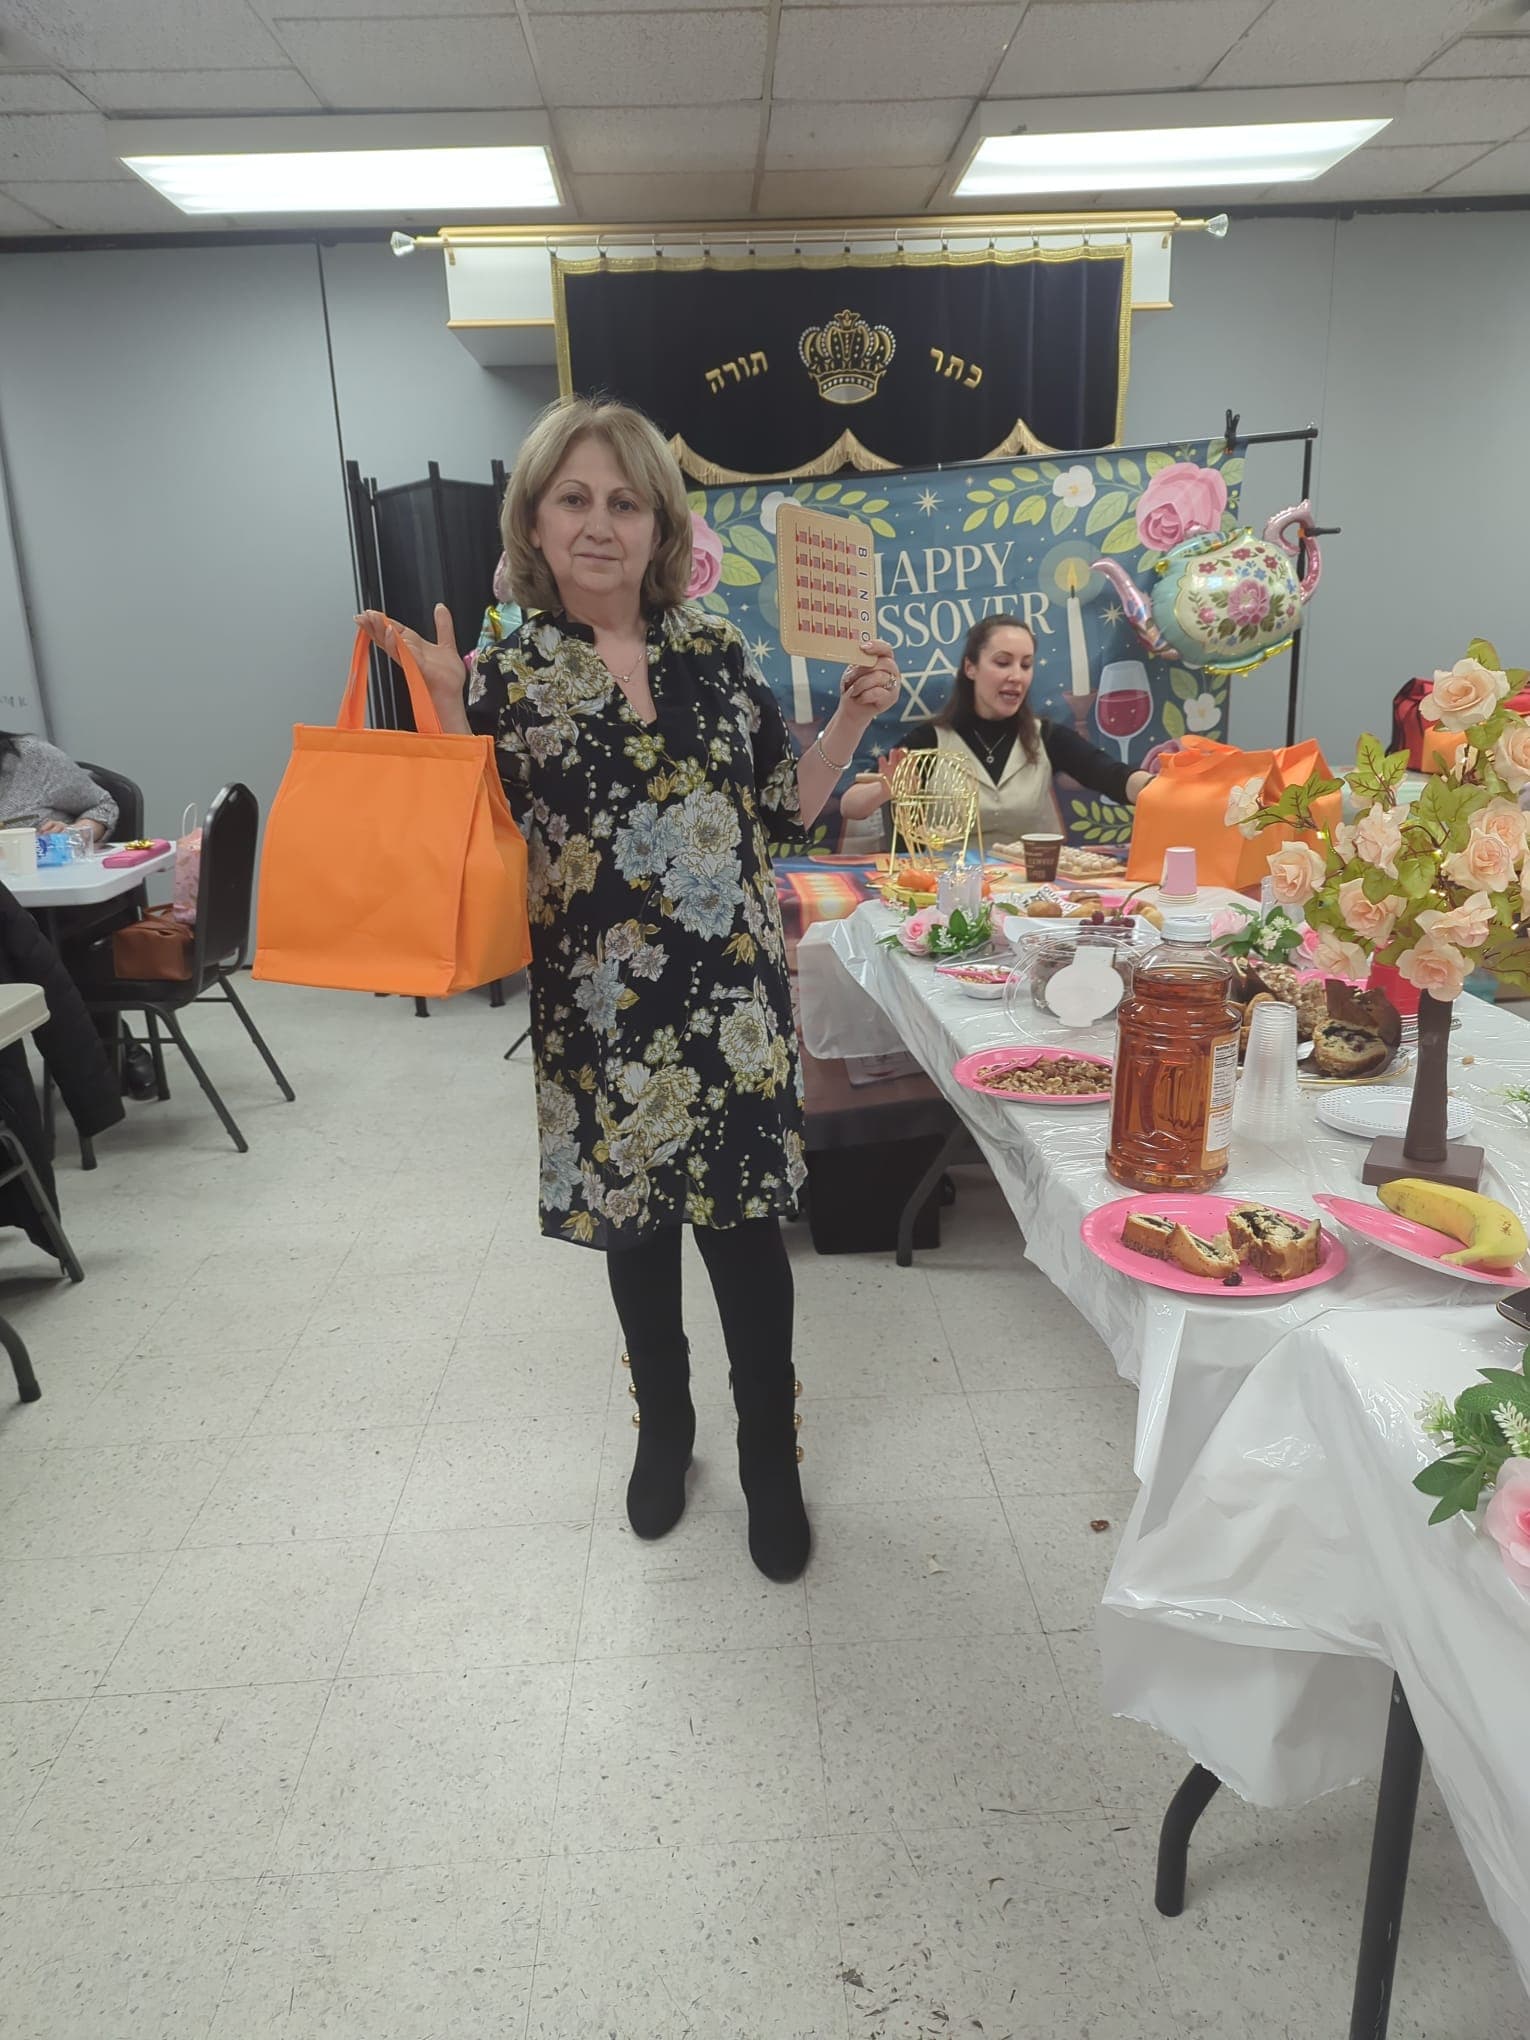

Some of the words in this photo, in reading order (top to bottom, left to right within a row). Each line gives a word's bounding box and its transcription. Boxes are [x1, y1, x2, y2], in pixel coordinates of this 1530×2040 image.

[705, 352, 768, 394] תורה
[930, 348, 983, 388] כתר
[858, 547, 870, 642] BINGO
[877, 591, 1055, 649] SSOVR
